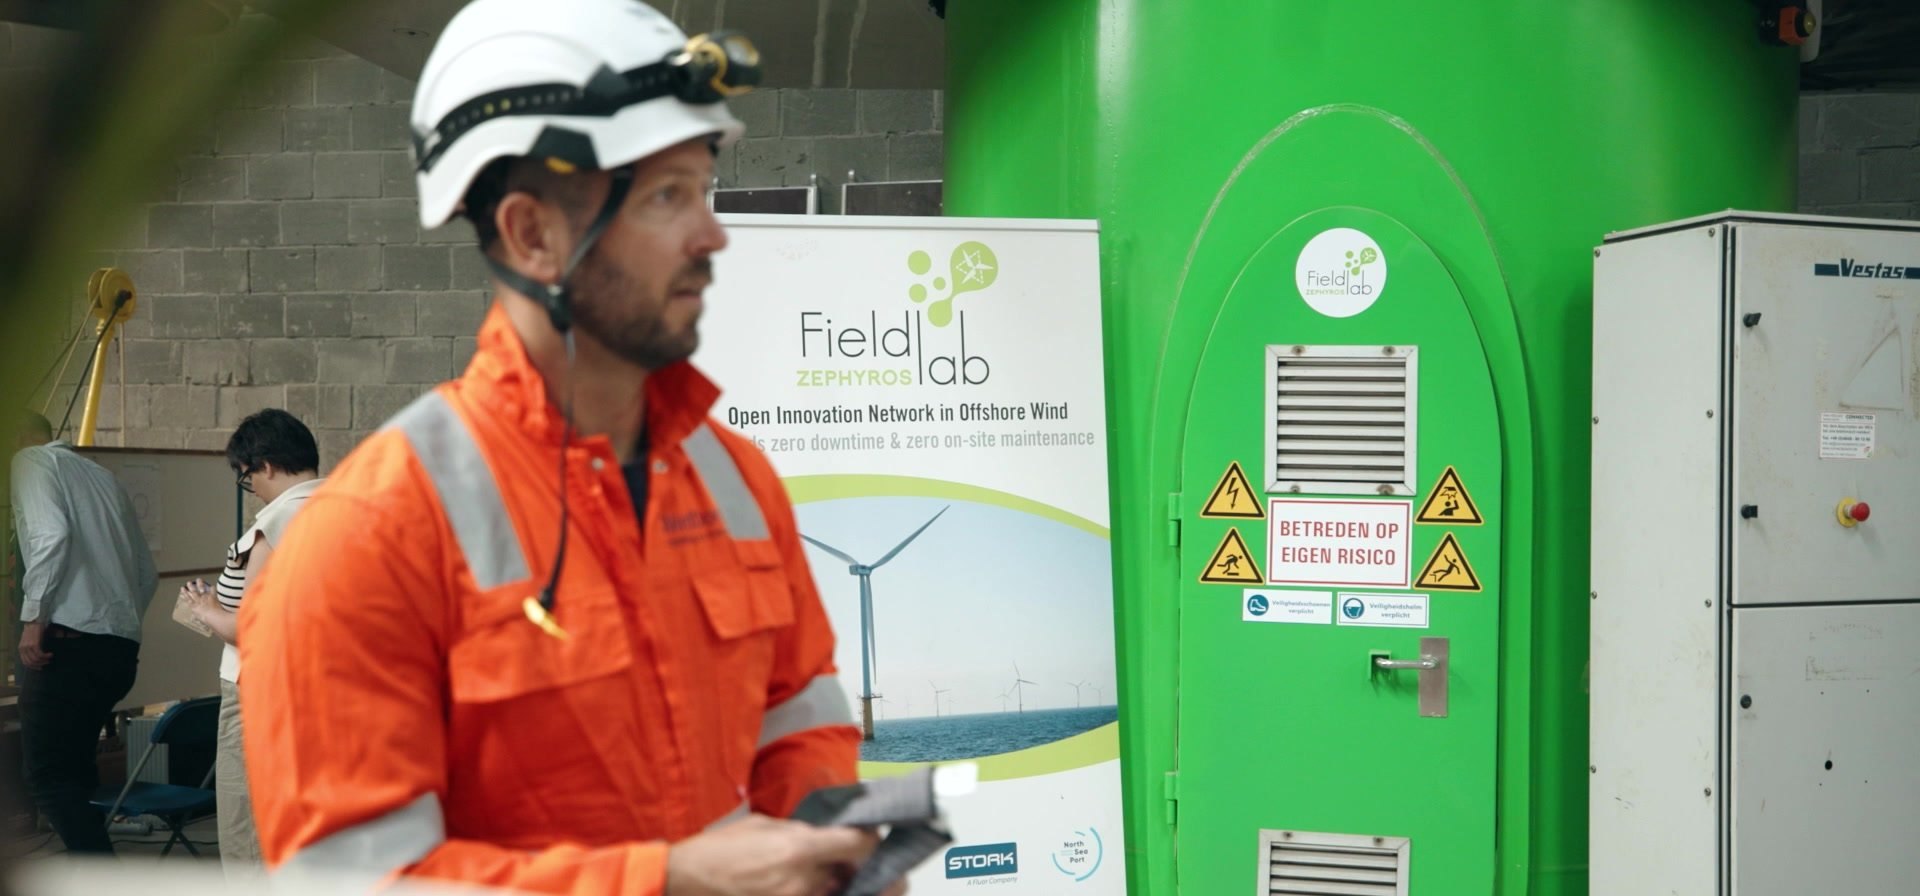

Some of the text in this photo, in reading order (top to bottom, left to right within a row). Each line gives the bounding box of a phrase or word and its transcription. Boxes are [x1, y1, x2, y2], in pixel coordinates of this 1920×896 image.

[1840, 258, 1904, 279] Vestas
[796, 368, 913, 388] ZEPHYROS
[728, 402, 1069, 429] Open Innovation Network in Offshore Wind
[771, 437, 806, 453] zero
[810, 433, 885, 452] downtime
[890, 432, 901, 450] &
[906, 434, 939, 450] zero
[944, 431, 996, 449] on-site
[1000, 429, 1095, 448] maintenance
[1279, 520, 1399, 539] BETREDEN OP
[1281, 546, 1396, 566] EIGEN RISICO
[1380, 611, 1410, 619] verplicht
[1063, 840, 1085, 849] North
[1074, 848, 1089, 856] Sea
[948, 852, 1015, 871] STORK
[1069, 856, 1086, 864] Port
[972, 877, 989, 887] Fluor
[988, 875, 1018, 886] Company
